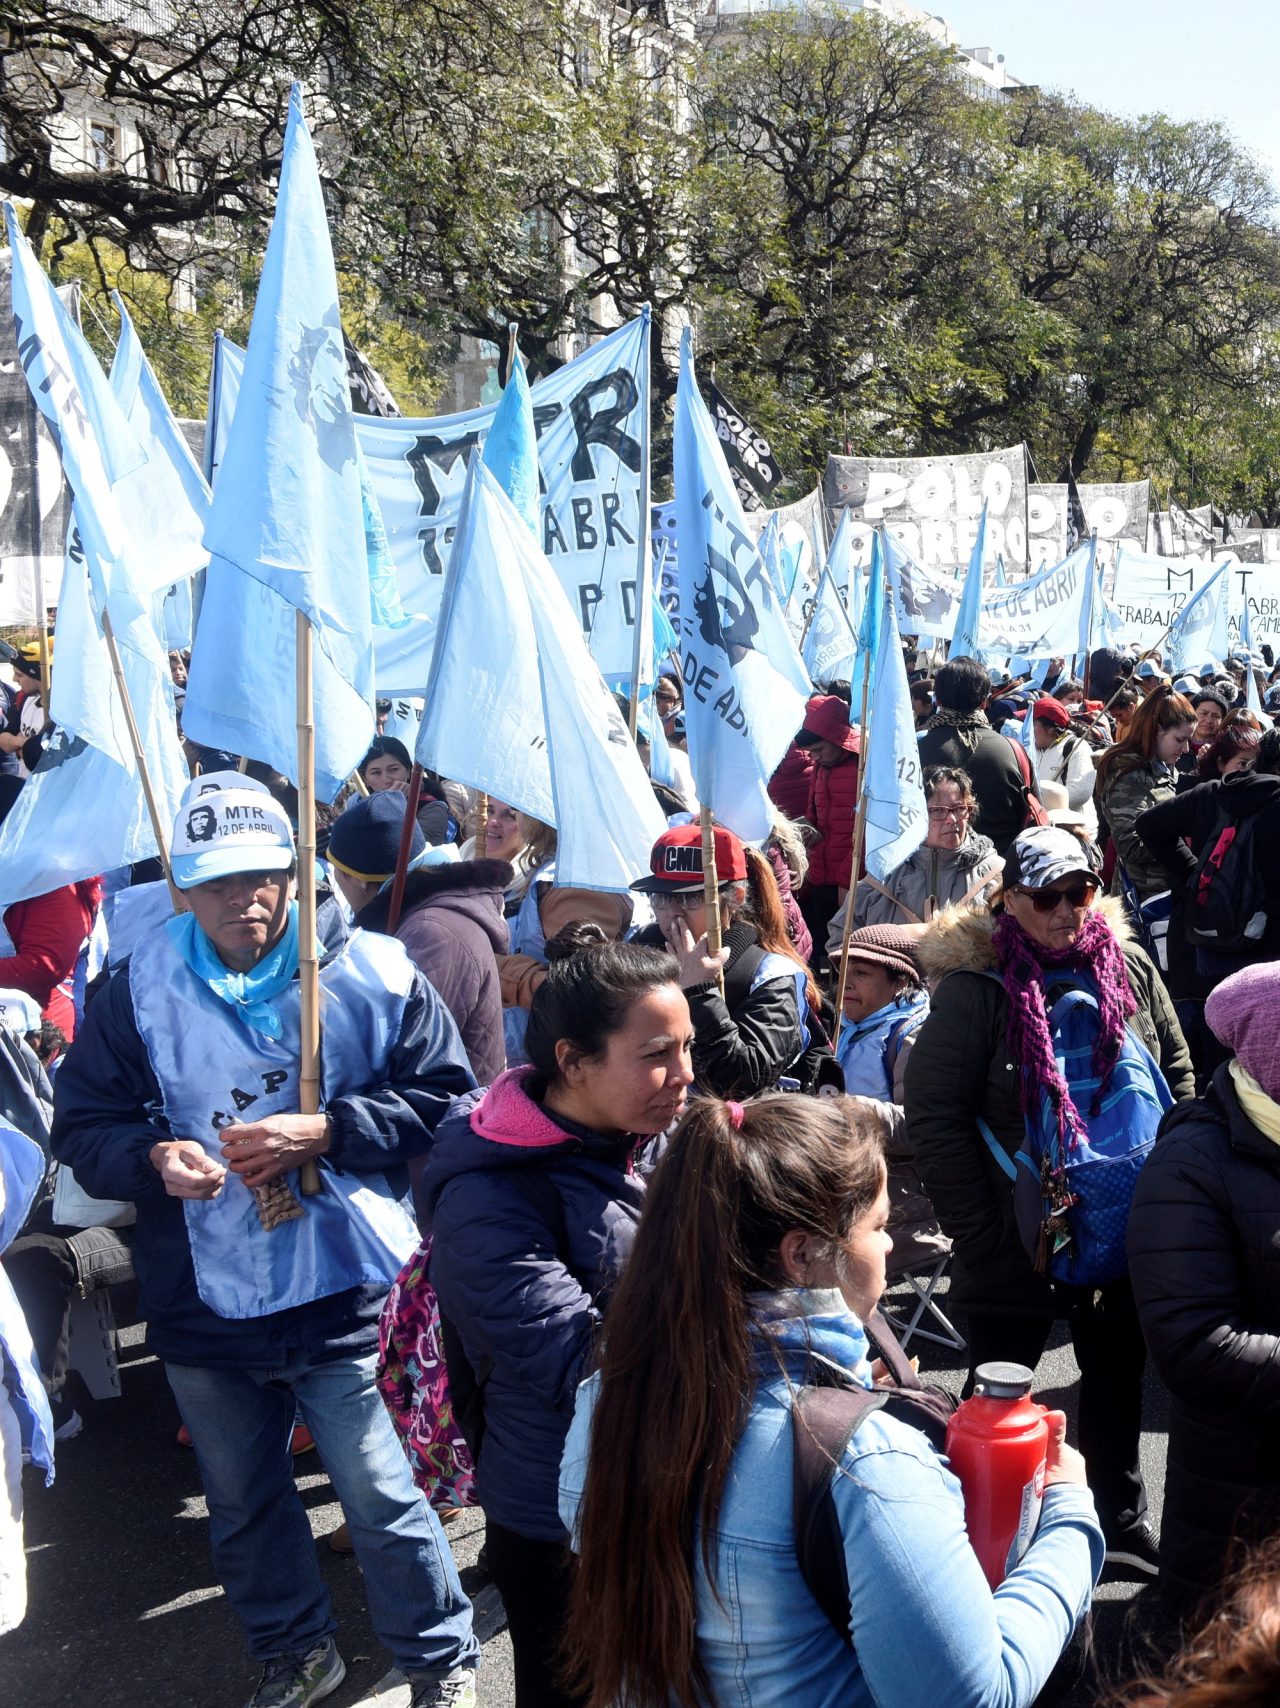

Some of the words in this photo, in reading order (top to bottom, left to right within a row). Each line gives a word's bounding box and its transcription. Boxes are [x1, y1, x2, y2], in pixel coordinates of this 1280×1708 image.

[864, 462, 1012, 519] POLO
[1167, 567, 1194, 592] M
[1235, 570, 1253, 595] T
[1167, 592, 1188, 610] 12
[683, 651, 719, 705] DE
[225, 806, 265, 820] MTR
[218, 824, 229, 837] 12
[231, 823, 245, 835] DE
[248, 823, 277, 835] ABRIL
